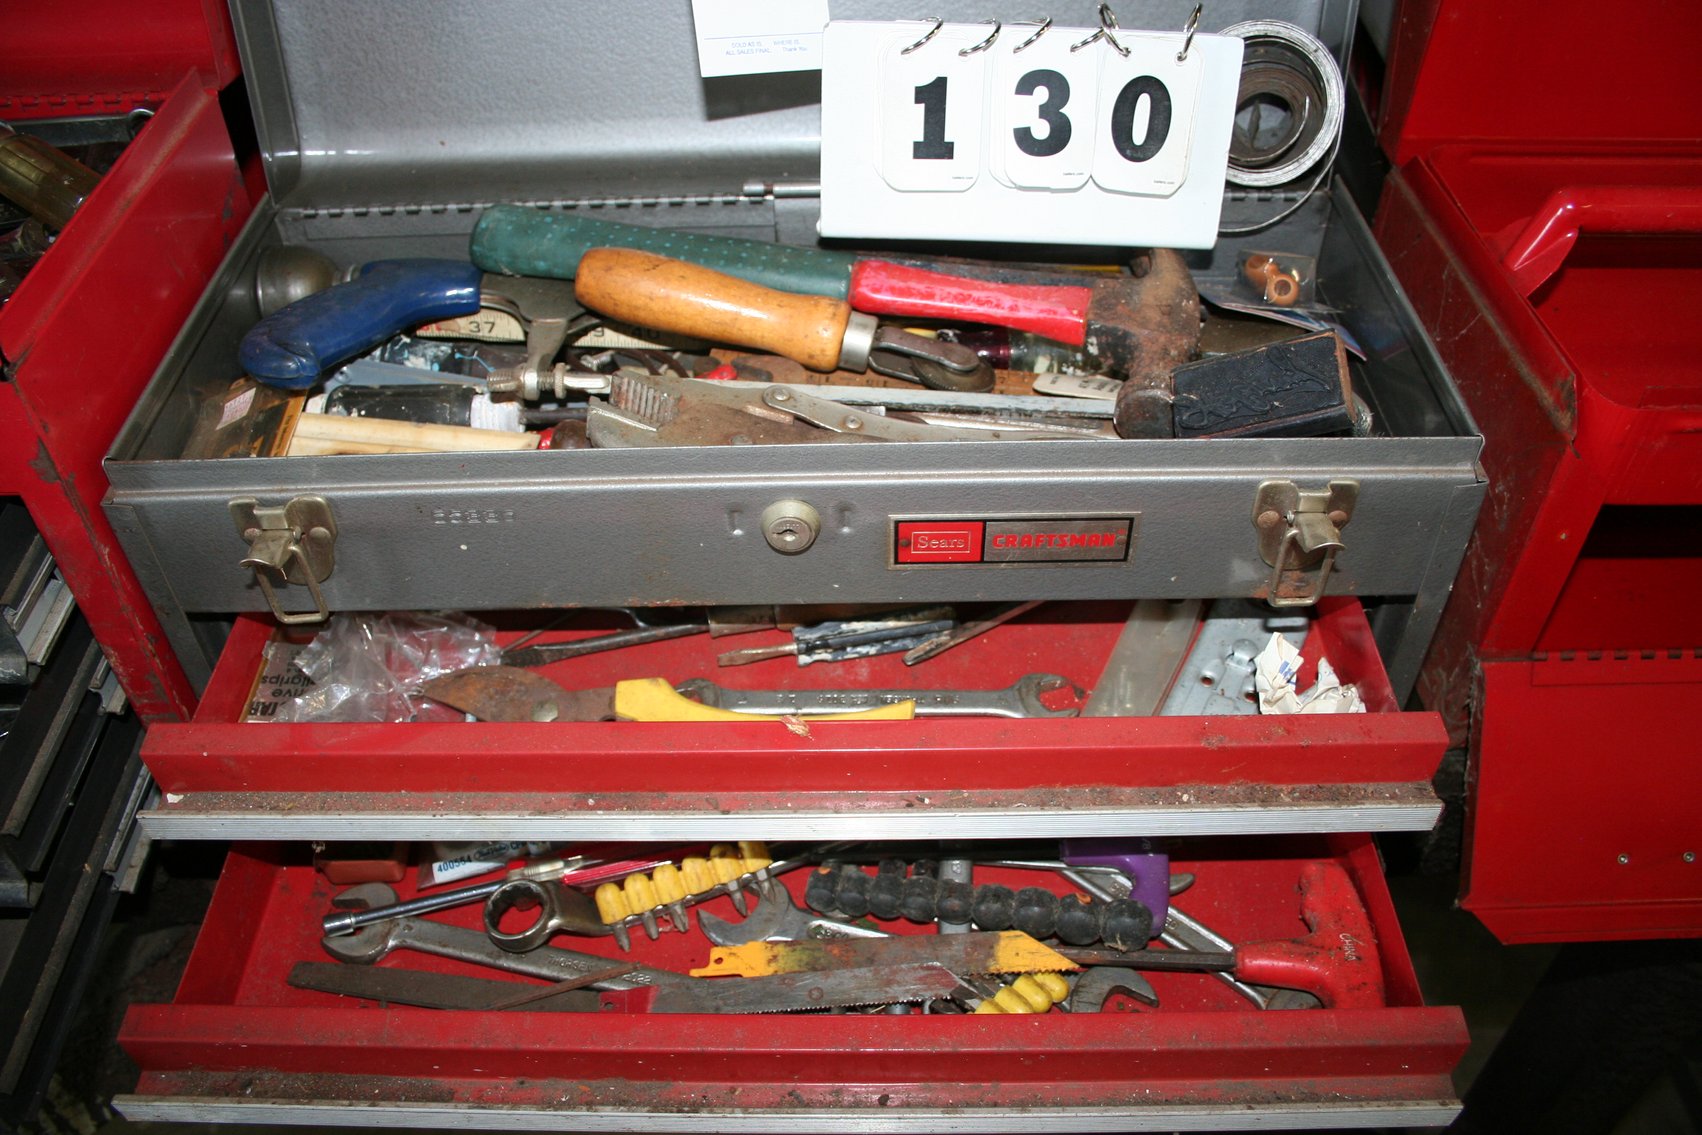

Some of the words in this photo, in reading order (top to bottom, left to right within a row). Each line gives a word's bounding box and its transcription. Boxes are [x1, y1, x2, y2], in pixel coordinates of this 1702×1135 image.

[468, 320, 495, 334] 37
[917, 534, 965, 549] Sears
[991, 533, 1116, 550] CRAFTSMAN
[1339, 933, 1359, 961] CHINA
